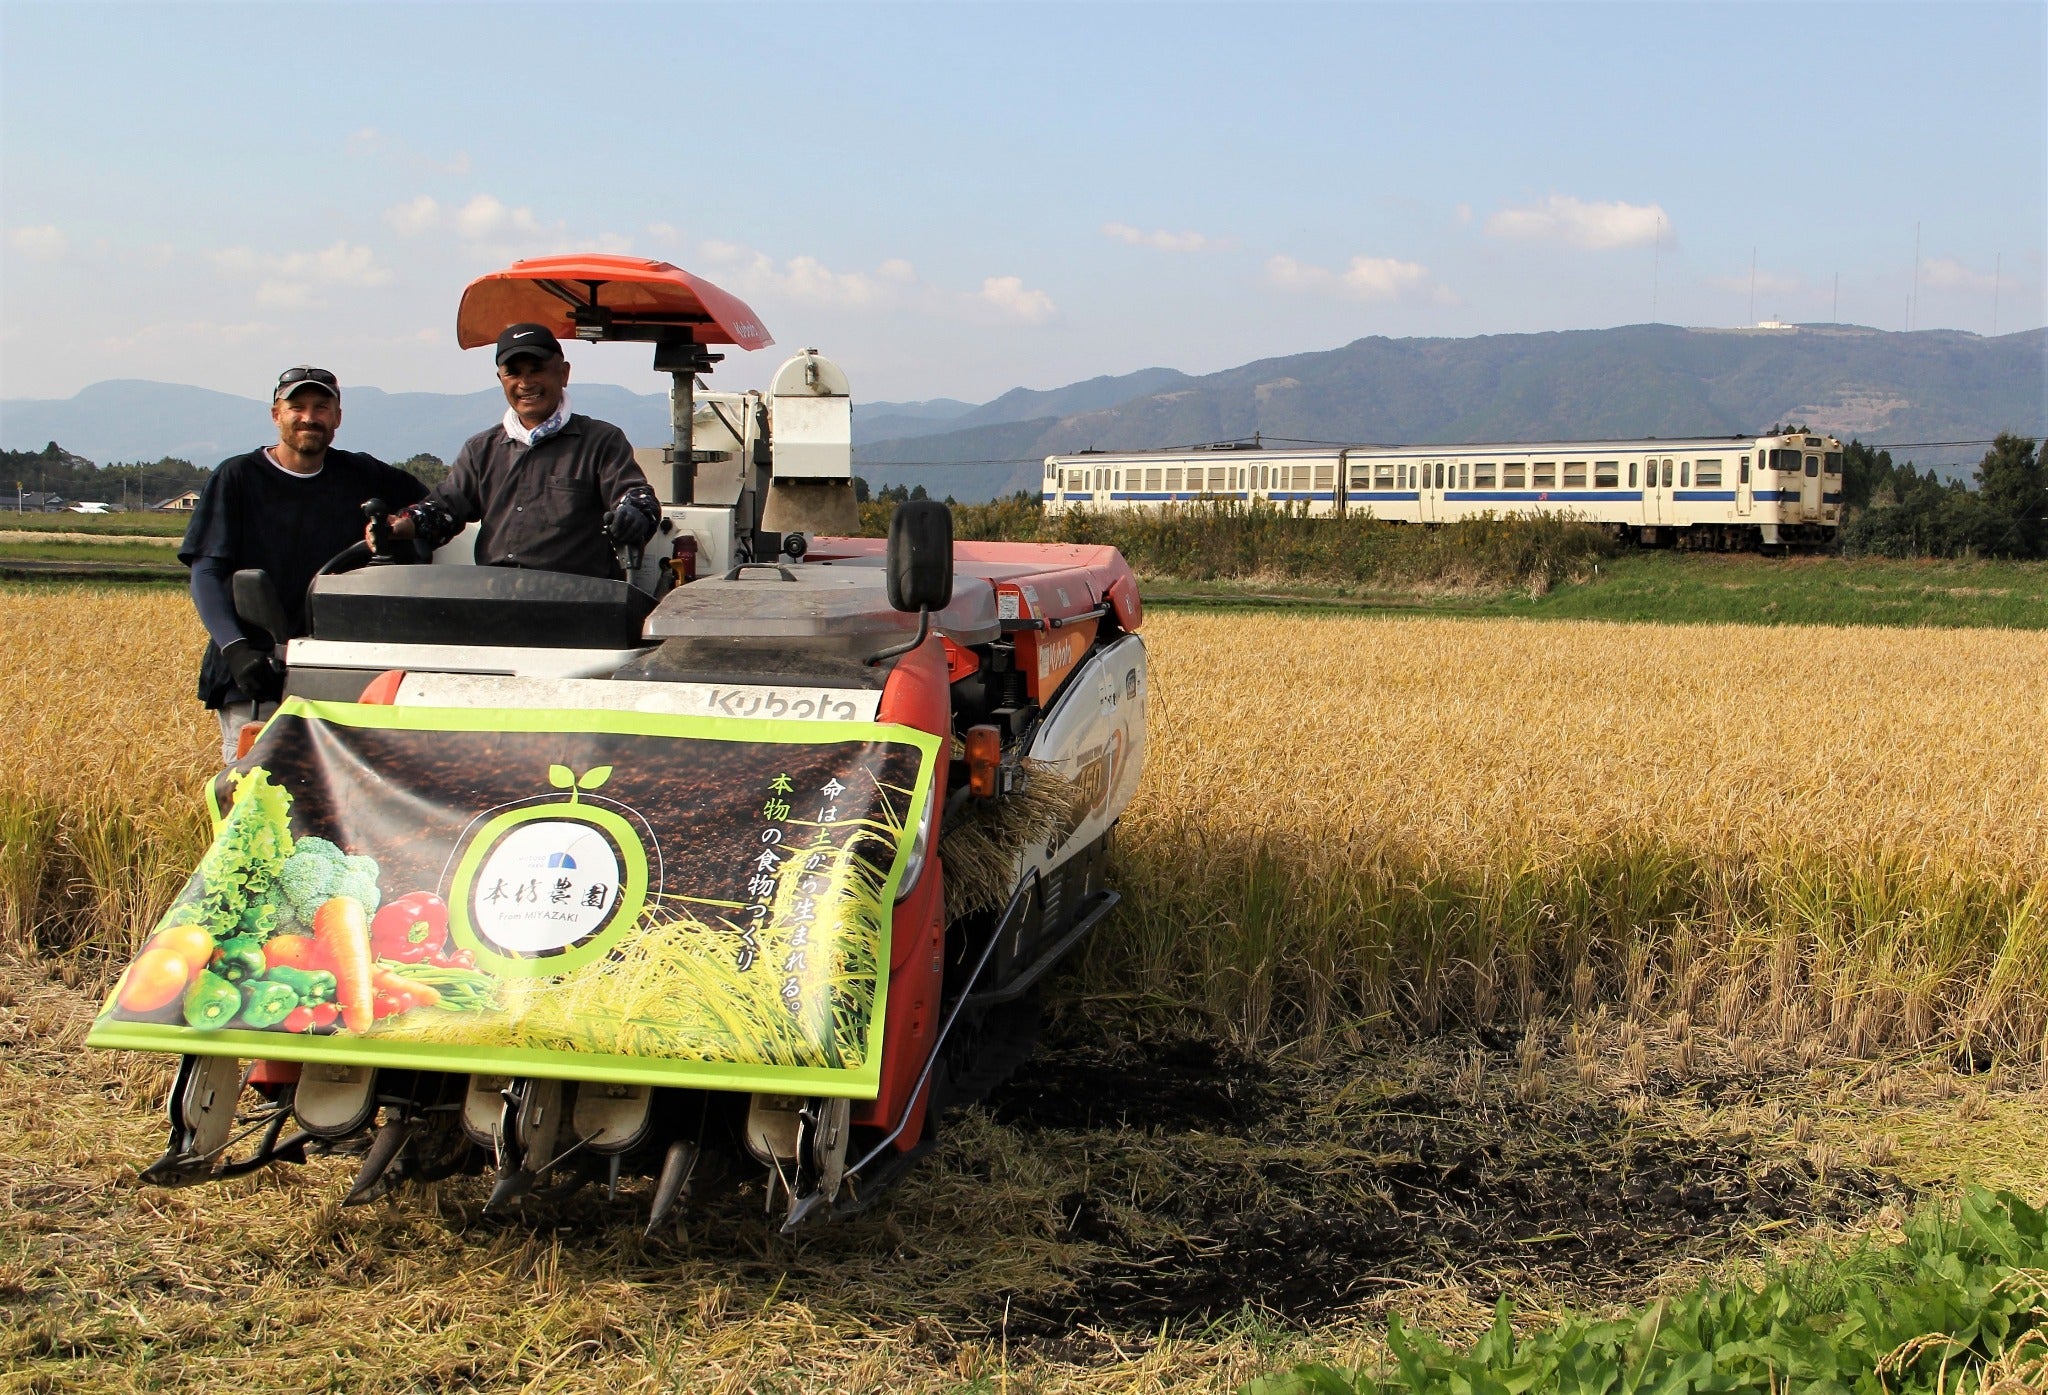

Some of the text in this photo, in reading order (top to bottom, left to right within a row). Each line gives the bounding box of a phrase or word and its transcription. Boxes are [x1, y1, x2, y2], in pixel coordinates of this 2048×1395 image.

[732, 320, 758, 338] Kubota
[1050, 638, 1072, 671] Kubota
[708, 689, 857, 721] Kubota
[499, 911, 579, 923] From MIYAZAKI
